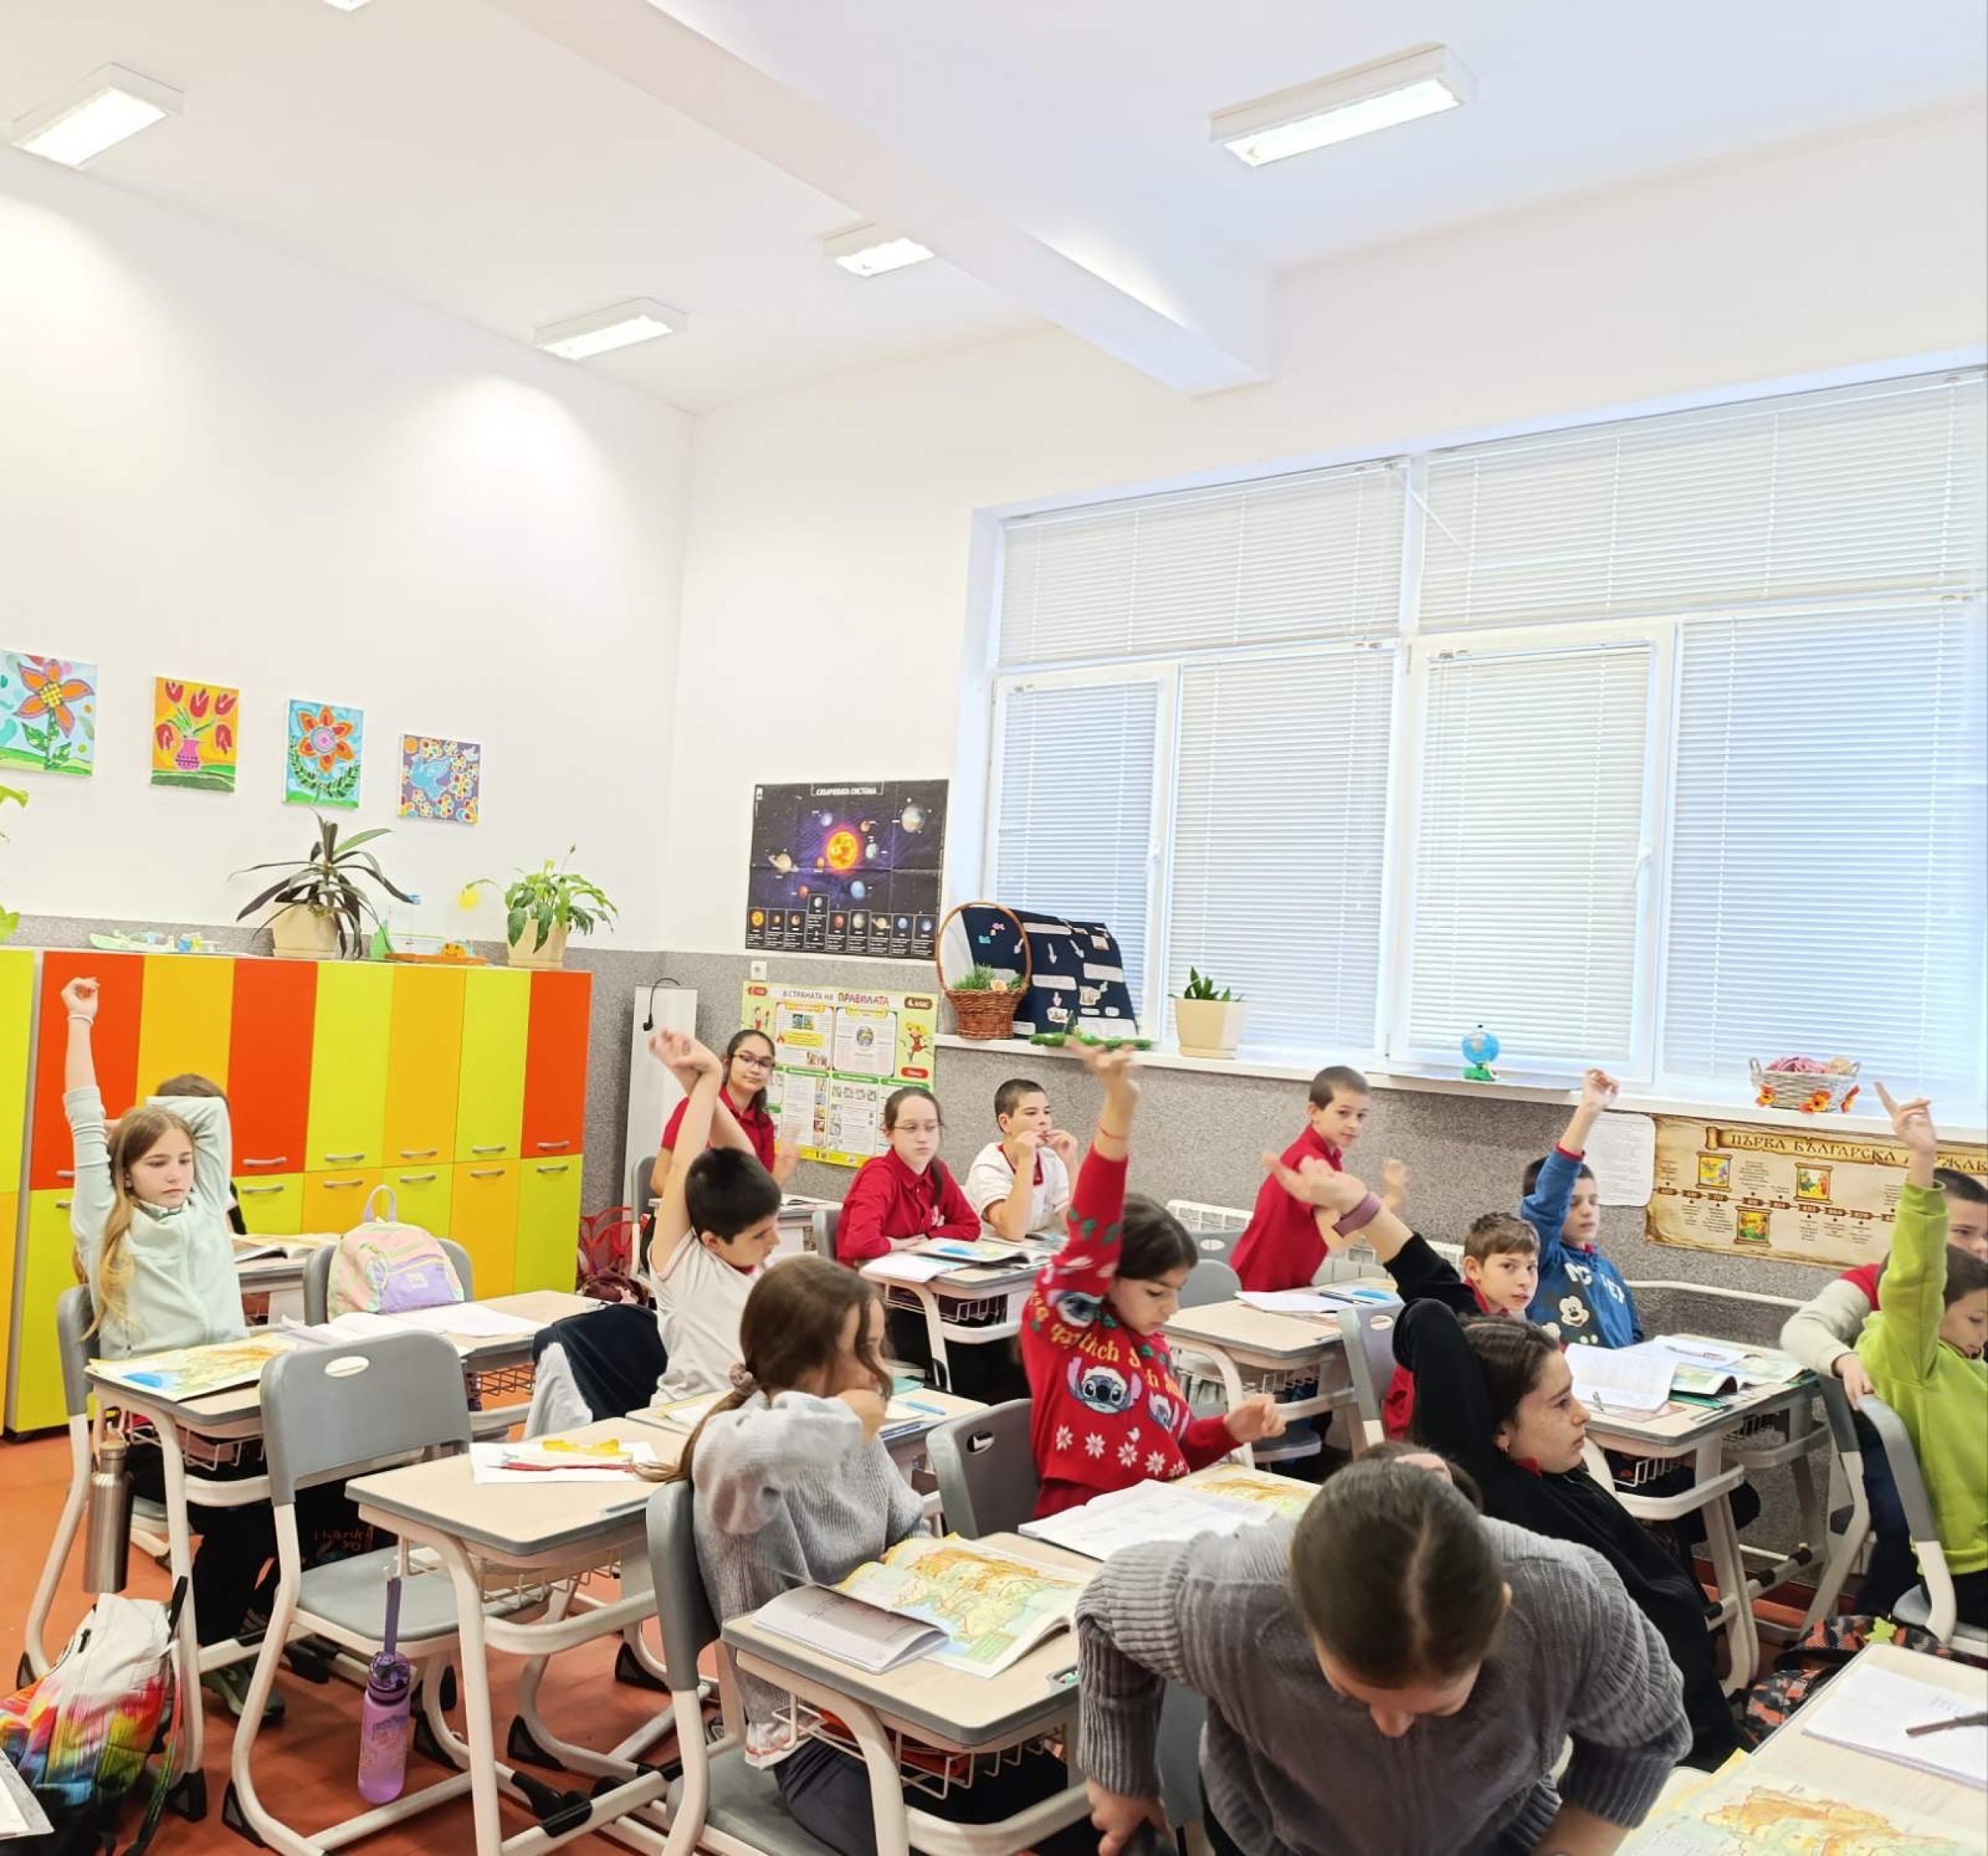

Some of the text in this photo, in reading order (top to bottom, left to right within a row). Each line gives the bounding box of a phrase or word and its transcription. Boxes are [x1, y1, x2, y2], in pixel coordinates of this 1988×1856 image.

[788, 990, 823, 1000] СТРАНАТА
[838, 992, 889, 1005] ПРАВИЛАТА
[1794, 1140, 1896, 1163] БЪЛГАРСКА
